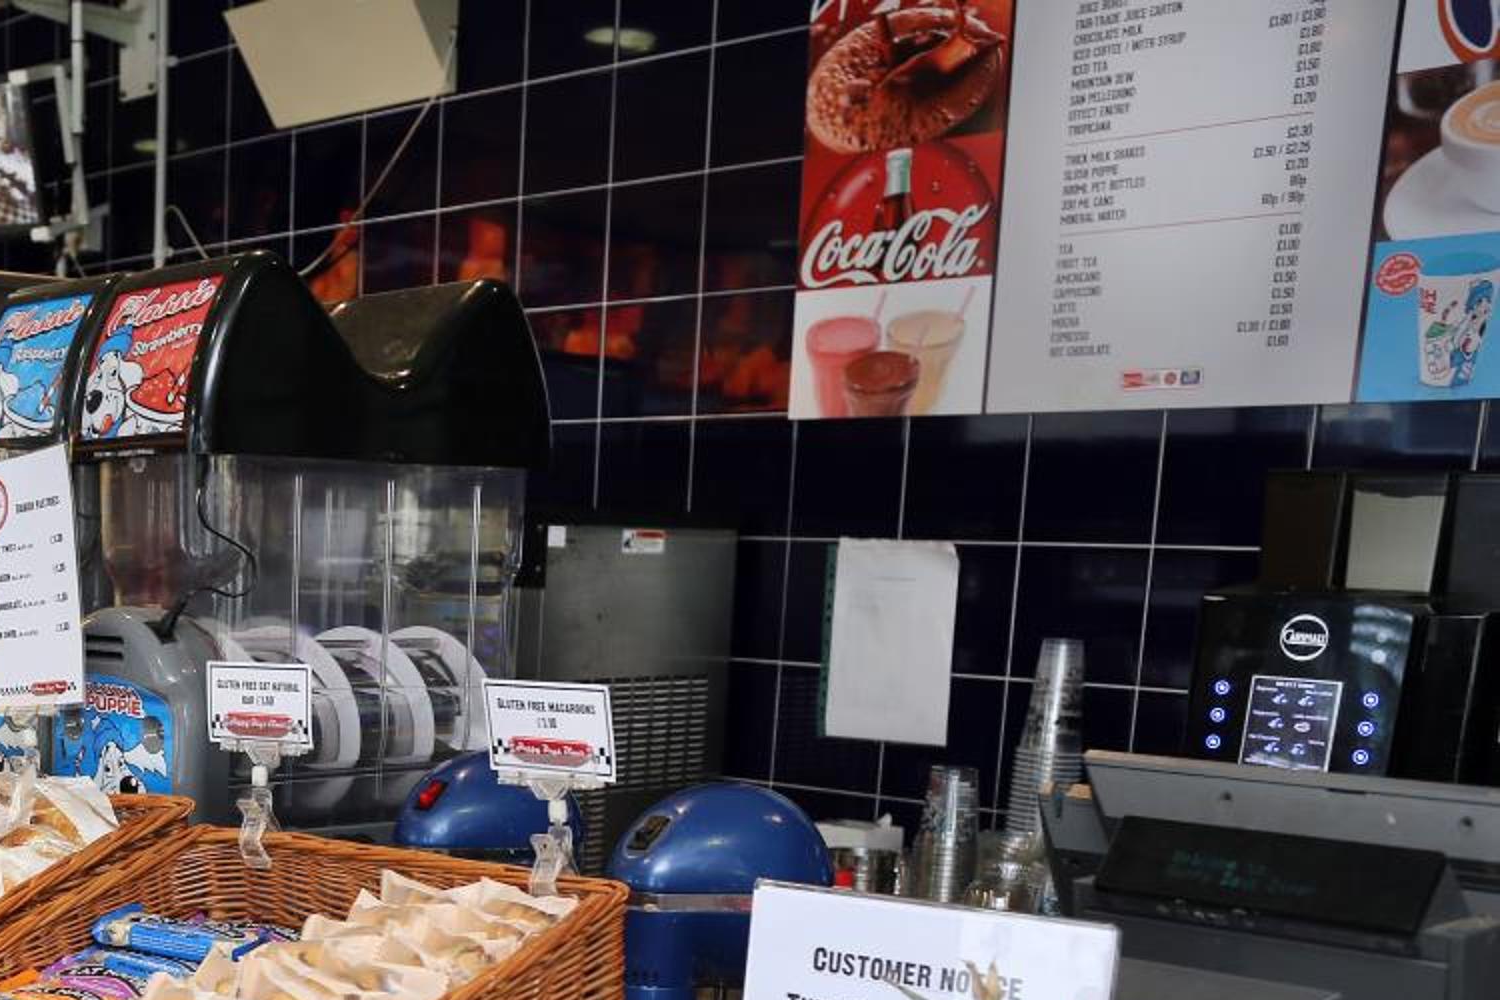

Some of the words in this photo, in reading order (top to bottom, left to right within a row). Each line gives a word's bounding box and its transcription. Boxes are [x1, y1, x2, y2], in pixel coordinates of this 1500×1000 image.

[801, 203, 990, 289] Coca-Cola
[497, 697, 526, 711] GLUTEN
[527, 700, 547, 713] FREE
[547, 702, 596, 715] MACAROONS
[813, 946, 931, 988] CUSTOMER
